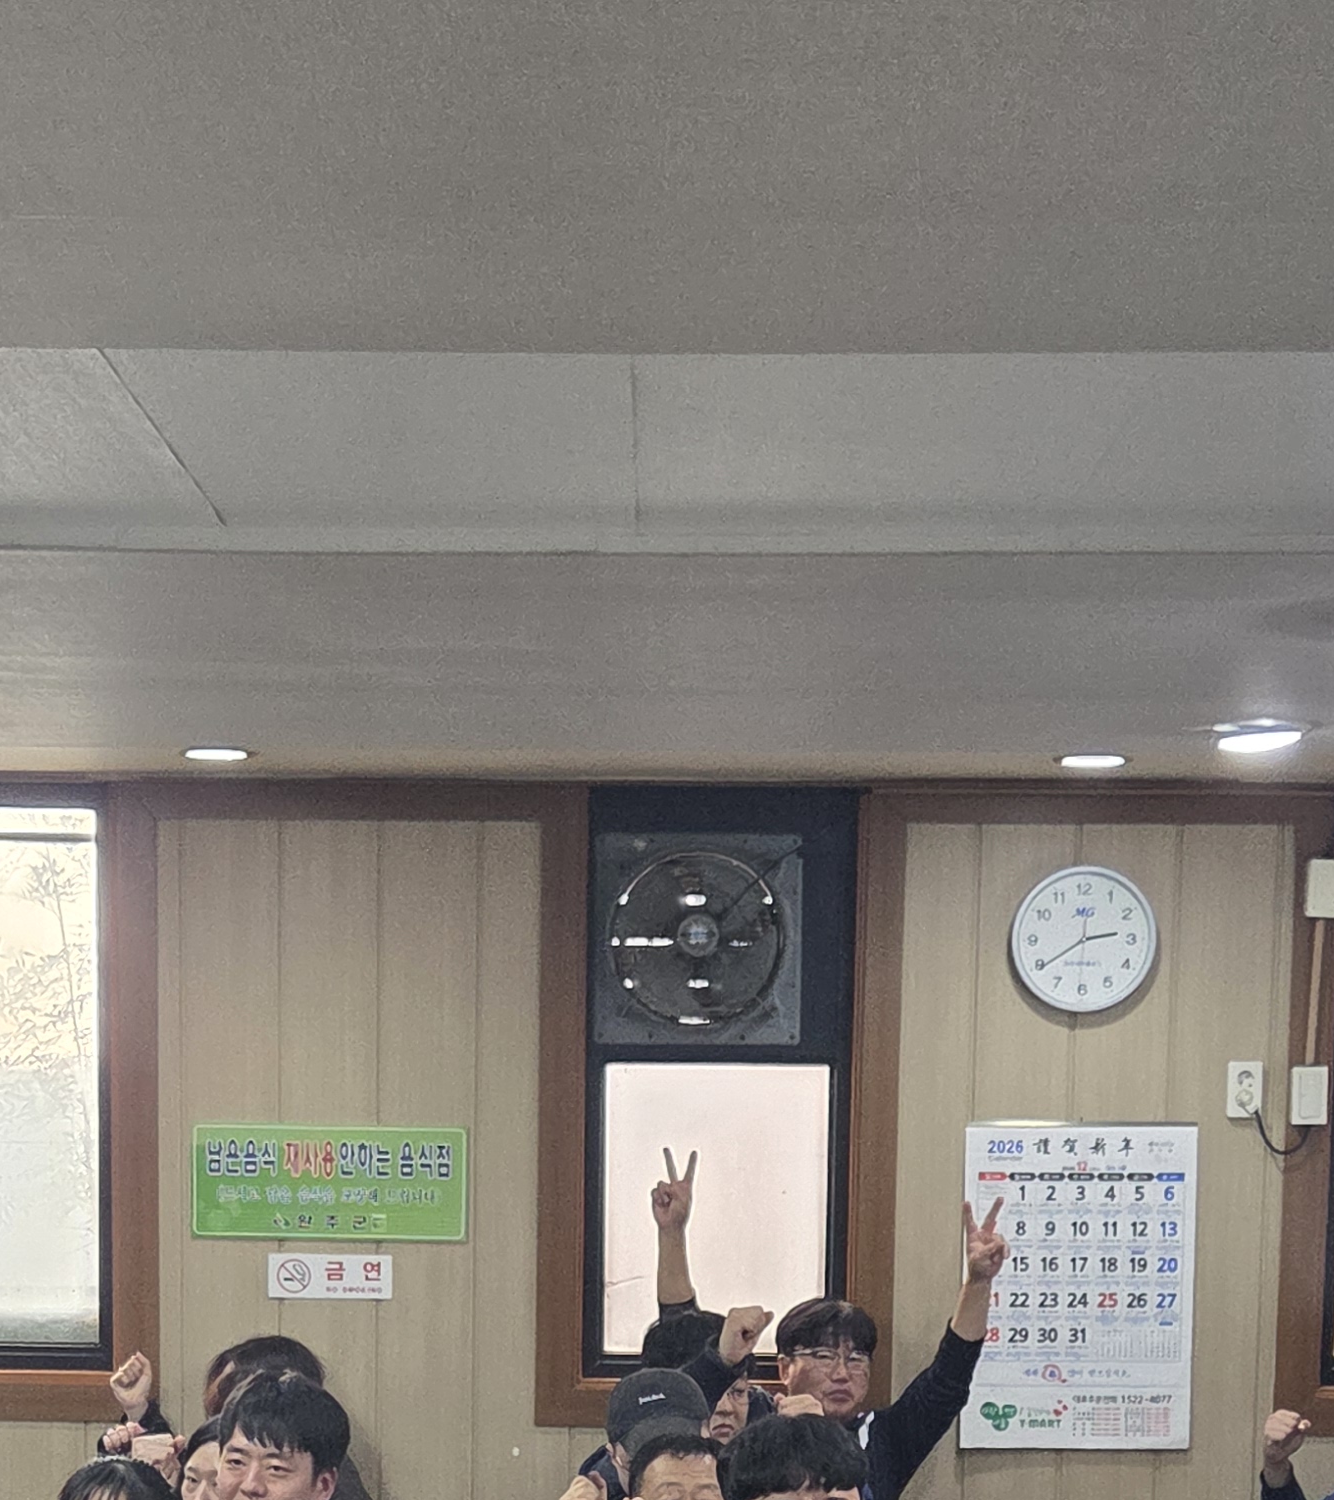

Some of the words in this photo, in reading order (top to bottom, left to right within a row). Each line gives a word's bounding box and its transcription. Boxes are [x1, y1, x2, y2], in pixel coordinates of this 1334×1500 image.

[1077, 883, 1092, 896] 12
[1053, 891, 1066, 904] 11
[1108, 890, 1113, 904] 1
[1036, 908, 1051, 921] 10
[1122, 907, 1133, 921] 2
[1027, 934, 1038, 947] 9
[1125, 933, 1137, 946] 3
[1121, 958, 1130, 970] 4
[1053, 976, 1063, 989] 7
[1103, 976, 1113, 988] 5
[1077, 984, 1087, 996] 6
[987, 1140, 1024, 1154] 2026
[206, 1139, 278, 1177] 남은음식
[398, 1141, 452, 1180] 음식점
[1019, 1185, 1026, 1201] 1
[1046, 1185, 1057, 1201] 2
[1075, 1185, 1086, 1201] 3
[1104, 1185, 1116, 1201] 4
[1134, 1185, 1145, 1201] 5
[1164, 1185, 1175, 1201] 6
[1016, 1221, 1026, 1236] 8
[1045, 1221, 1056, 1236] 9
[1071, 1221, 1089, 1236] 10
[1102, 1221, 1117, 1236] 11
[1131, 1221, 1148, 1236] 12
[1160, 1221, 1178, 1236] 13
[1012, 1257, 1029, 1273] 15
[1040, 1257, 1059, 1273] 16
[1070, 1257, 1088, 1273] 17
[1099, 1257, 1118, 1273] 18
[1129, 1257, 1147, 1273] 19
[1157, 1257, 1178, 1273] 20
[989, 1292, 999, 1308] 1
[1009, 1292, 1030, 1308] 22
[1038, 1292, 1059, 1308] 23
[1067, 1292, 1089, 1308] 24
[1097, 1292, 1118, 1308] 25
[1127, 1292, 1147, 1308] 26
[1155, 1292, 1177, 1308] 27
[1008, 1327, 1029, 1343] 29
[1037, 1327, 1058, 1343] 30
[1068, 1327, 1087, 1343] 31
